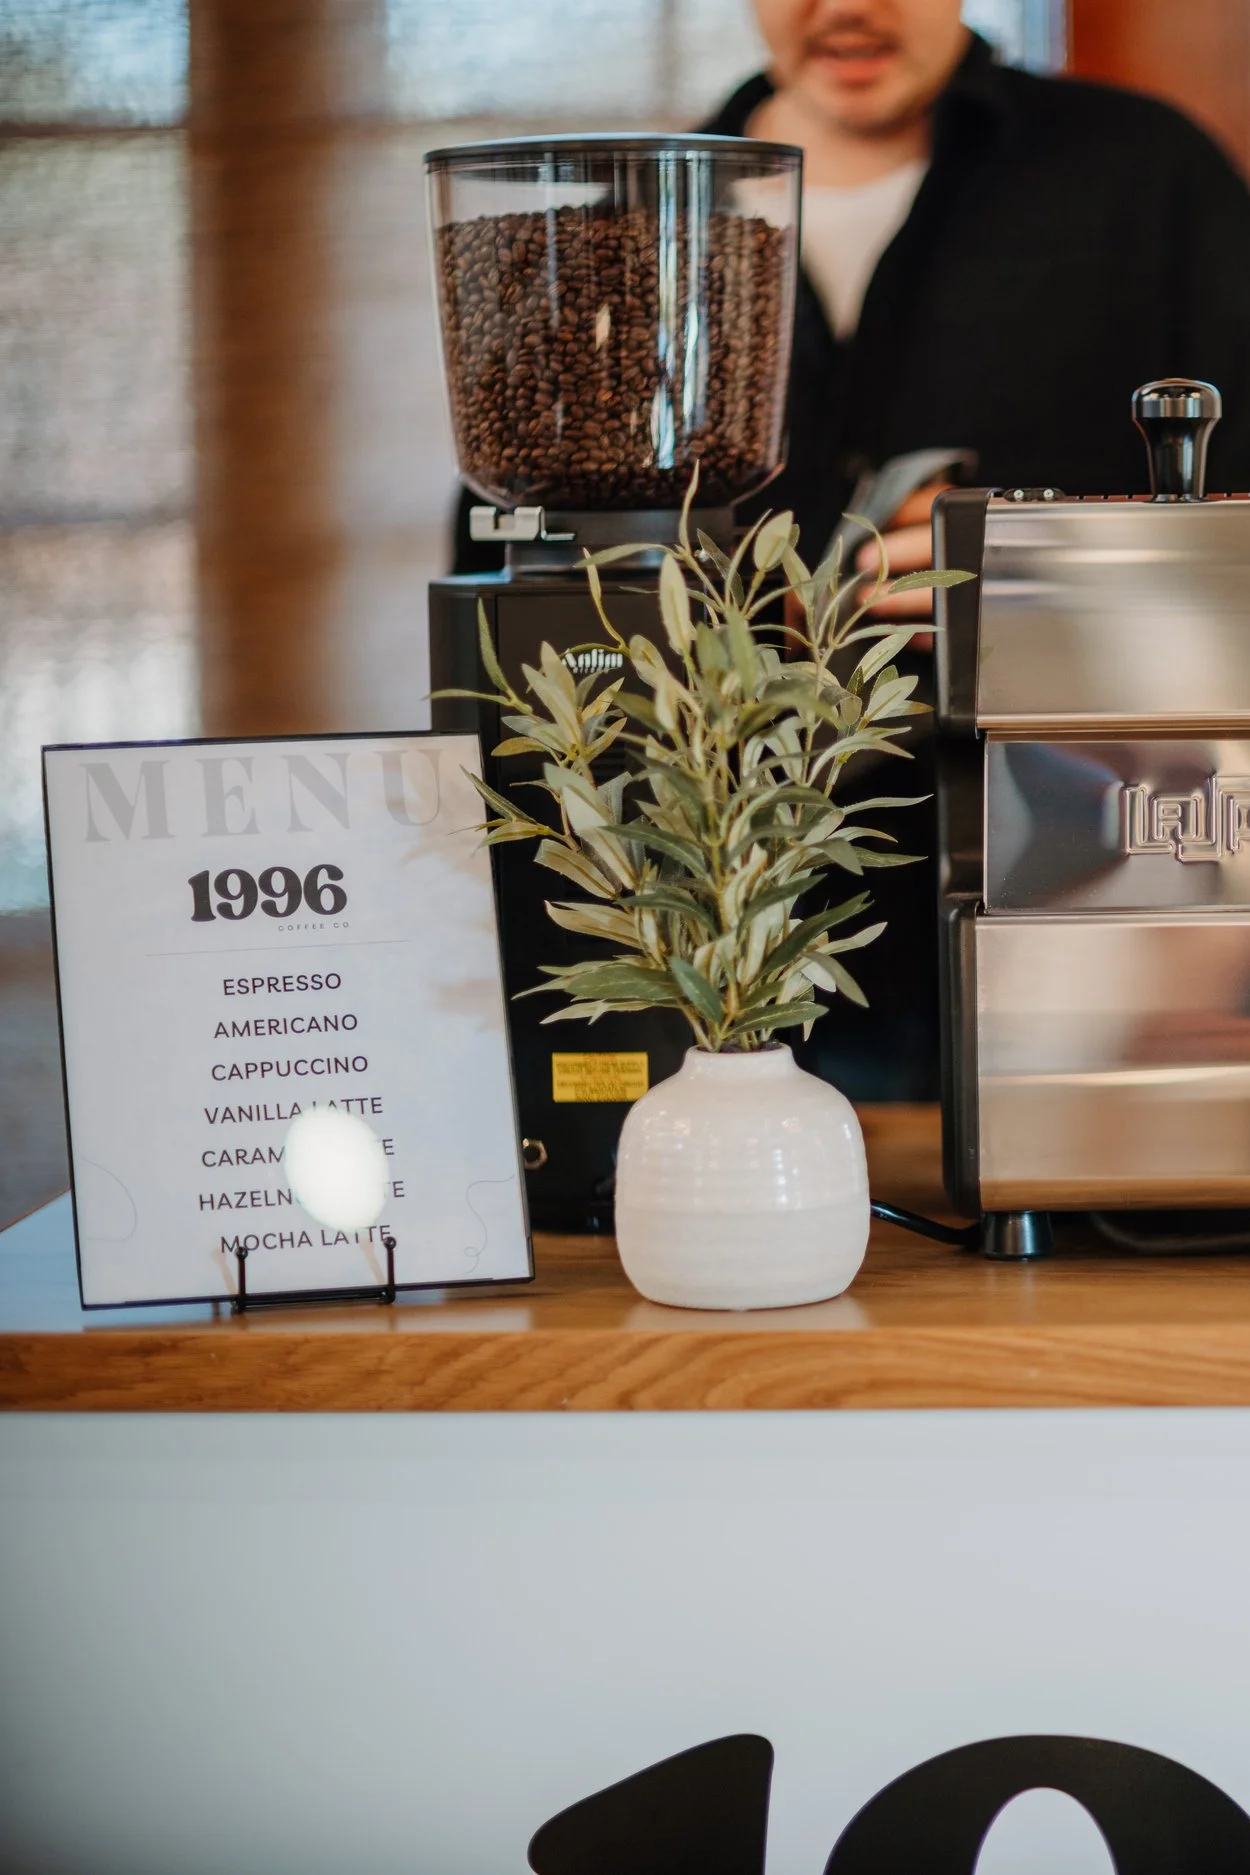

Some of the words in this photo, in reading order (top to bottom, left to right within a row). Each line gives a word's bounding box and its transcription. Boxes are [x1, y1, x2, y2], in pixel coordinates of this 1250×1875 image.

[79, 748, 444, 843] MENU
[188, 863, 347, 923] 1996
[278, 922, 325, 932] COFFEE
[222, 971, 342, 997] ESPRESSO
[213, 1013, 359, 1039] AMERICANO
[210, 1055, 369, 1082] CAPPUCCINO
[203, 1101, 304, 1125] VANILLA
[312, 1096, 384, 1119] TTE
[201, 1145, 286, 1168] CARAM
[198, 1188, 300, 1212] HAZELN
[220, 1230, 313, 1254] MOCHA
